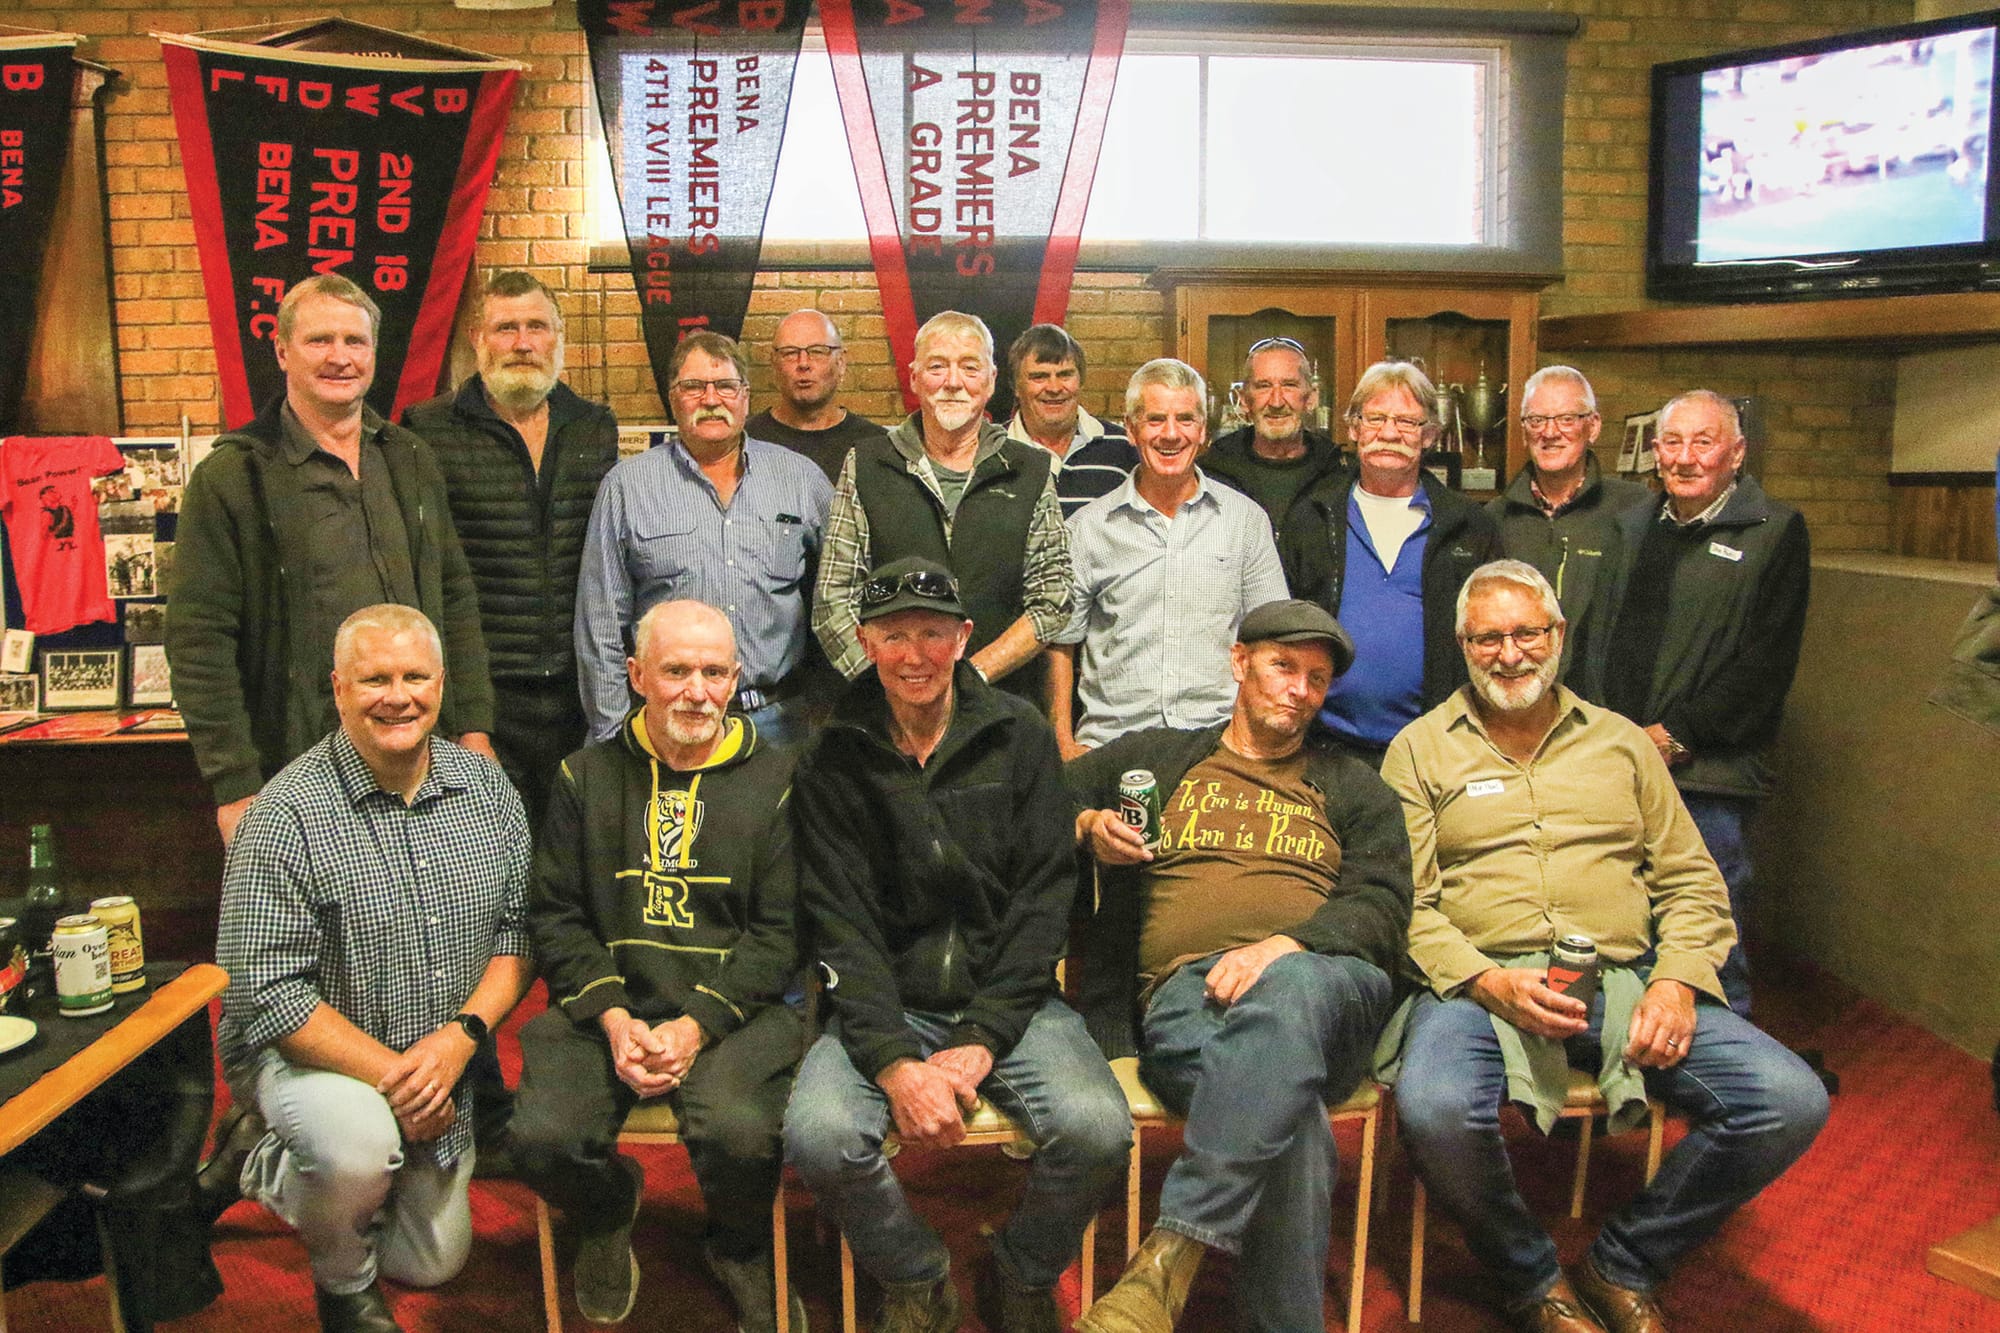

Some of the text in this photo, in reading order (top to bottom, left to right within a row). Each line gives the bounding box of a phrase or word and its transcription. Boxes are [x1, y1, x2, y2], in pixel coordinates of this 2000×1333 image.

[736, 55, 760, 134] BENA
[1008, 71, 1041, 178] BENA
[0, 130, 24, 209] BENA
[253, 142, 293, 251] BENA
[645, 58, 671, 305] 4TH XVIII LEAGUE
[688, 59, 719, 255] PREMIERS
[910, 63, 943, 257] A GRADE
[956, 71, 995, 277] PREMIERS
[373, 152, 413, 292] 2ND 18
[1177, 809, 1225, 851] Arr
[1236, 823, 1254, 849] is
[1265, 812, 1326, 862] Pirate
[1179, 779, 1199, 812] To
[1200, 782, 1229, 813] Err
[1235, 792, 1249, 810] is
[110, 944, 143, 961] REAT
